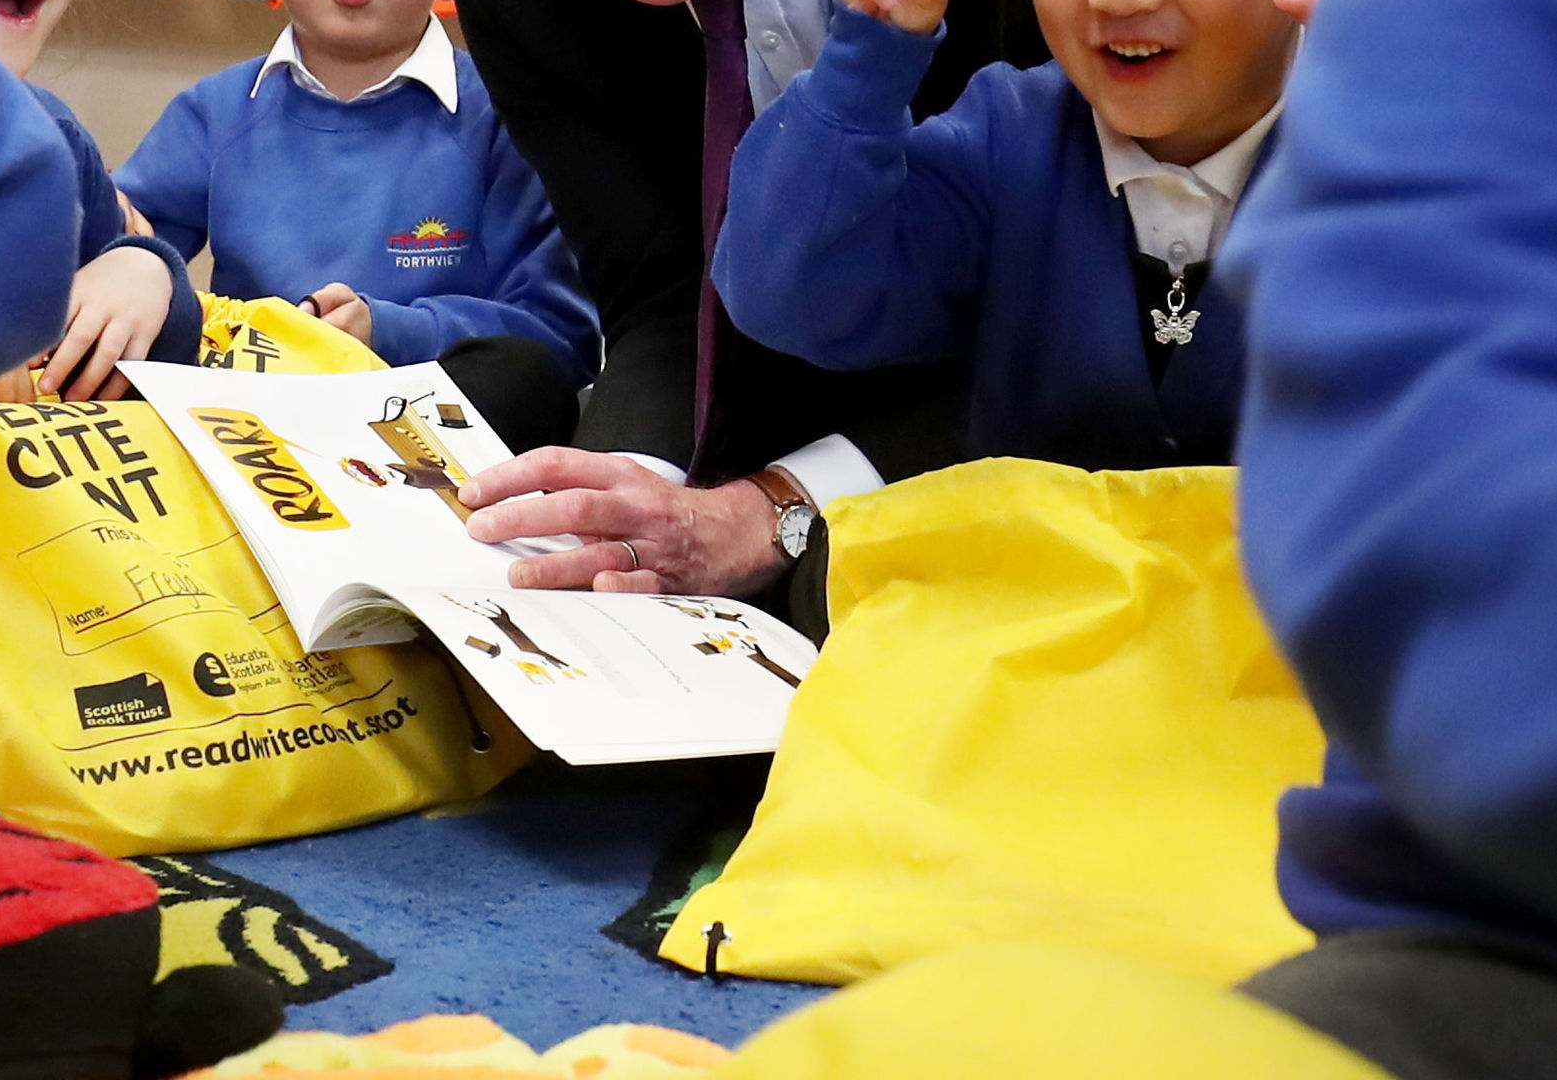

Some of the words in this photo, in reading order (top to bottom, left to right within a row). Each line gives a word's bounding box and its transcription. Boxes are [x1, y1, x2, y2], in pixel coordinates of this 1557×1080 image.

[198, 412, 335, 523] ROAR!
[66, 604, 110, 629] Name:
[83, 698, 145, 719] Scottish
[124, 705, 165, 723] Trust
